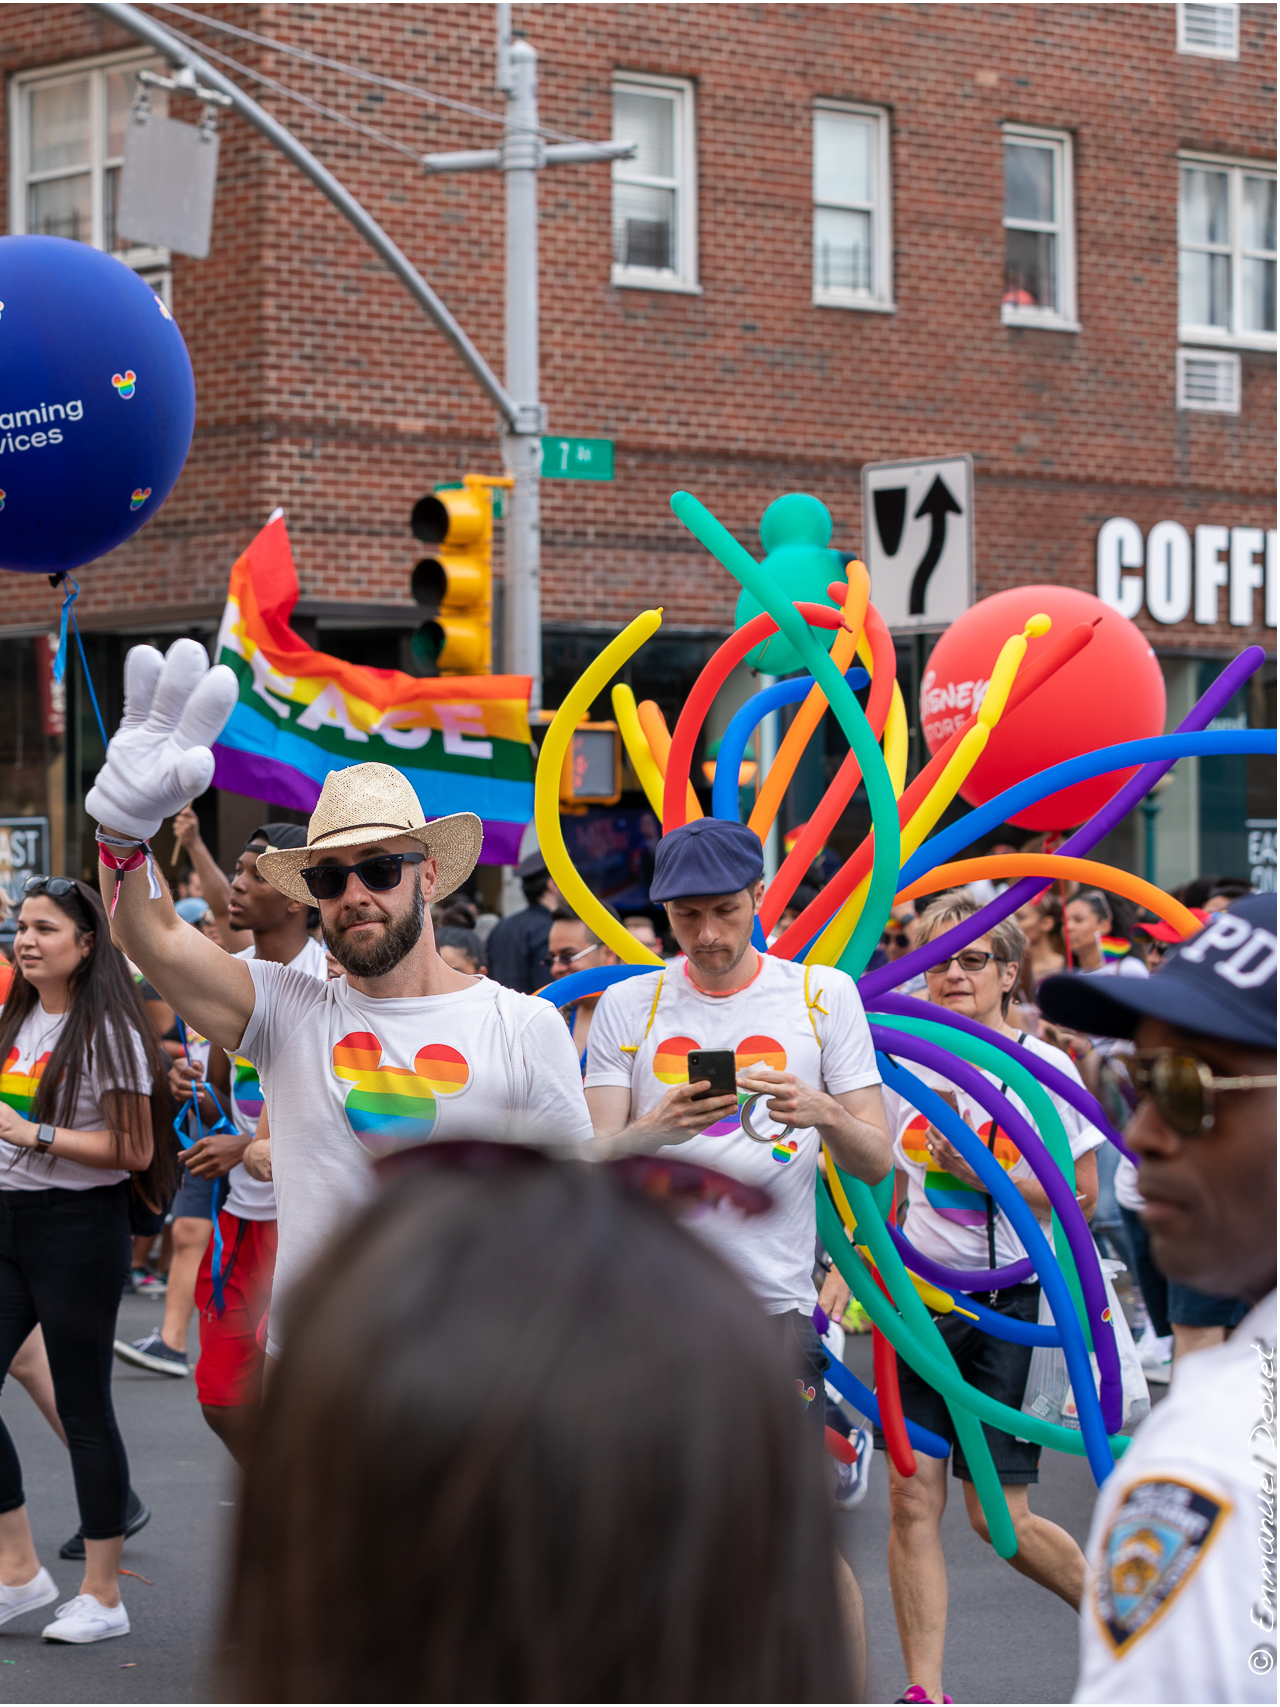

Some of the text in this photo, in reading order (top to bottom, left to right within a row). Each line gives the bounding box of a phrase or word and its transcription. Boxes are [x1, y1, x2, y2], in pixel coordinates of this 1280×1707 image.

[1097, 516, 1277, 626] COFF
[920, 669, 991, 721] ISNEY
[923, 712, 966, 742] TORE
[1248, 830, 1277, 865] EA
[1180, 913, 1277, 989] PD
